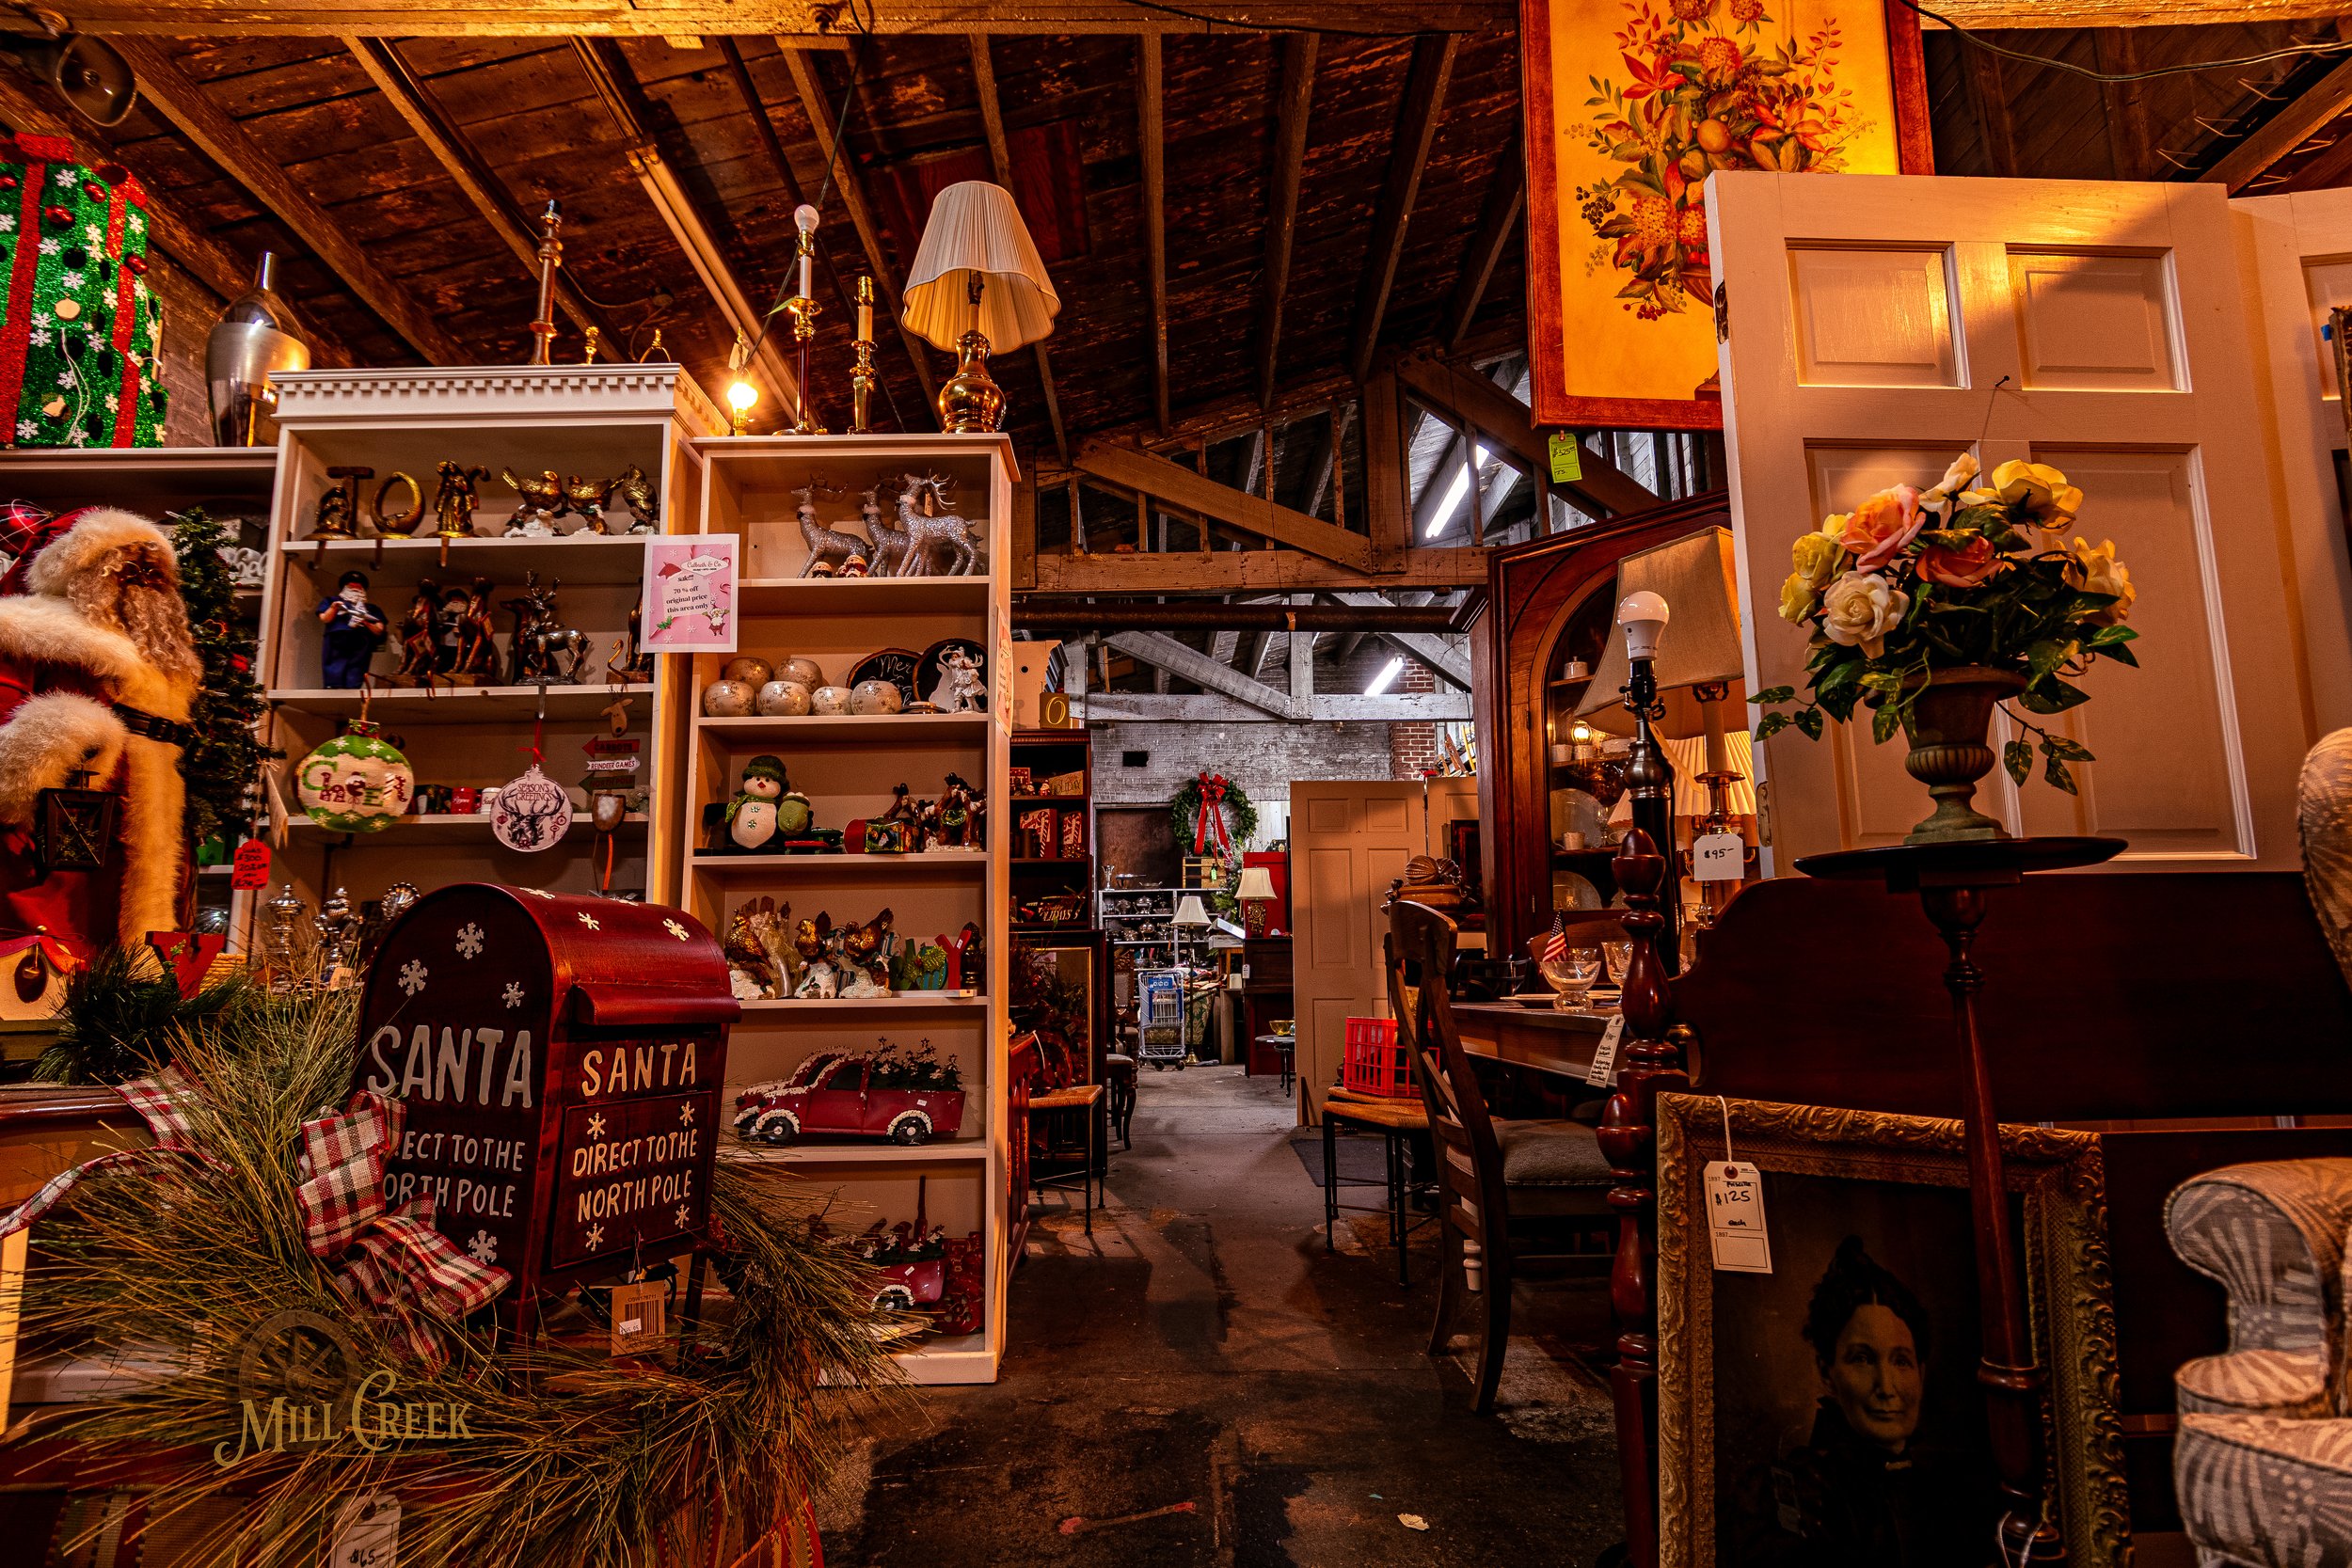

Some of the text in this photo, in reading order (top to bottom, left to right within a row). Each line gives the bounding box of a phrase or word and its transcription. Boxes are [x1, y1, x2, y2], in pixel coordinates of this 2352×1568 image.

[666, 594, 707, 605] original price
[695, 602, 709, 610] only
[876, 656, 913, 677] Mer
[615, 760, 635, 768] GAMES
[516, 792, 552, 801] GREETINGS
[517, 784, 550, 793] SEASON'S
[367, 1024, 532, 1109] SANTA
[581, 1042, 696, 1097] SANTA
[452, 1134, 479, 1164] TO
[484, 1138, 526, 1172] THE
[572, 1128, 698, 1178] DIRECT TO THE
[383, 1172, 516, 1218] ORTH POLE
[578, 1169, 691, 1223] NORTH POLE
[1715, 1190, 1751, 1207] $125
